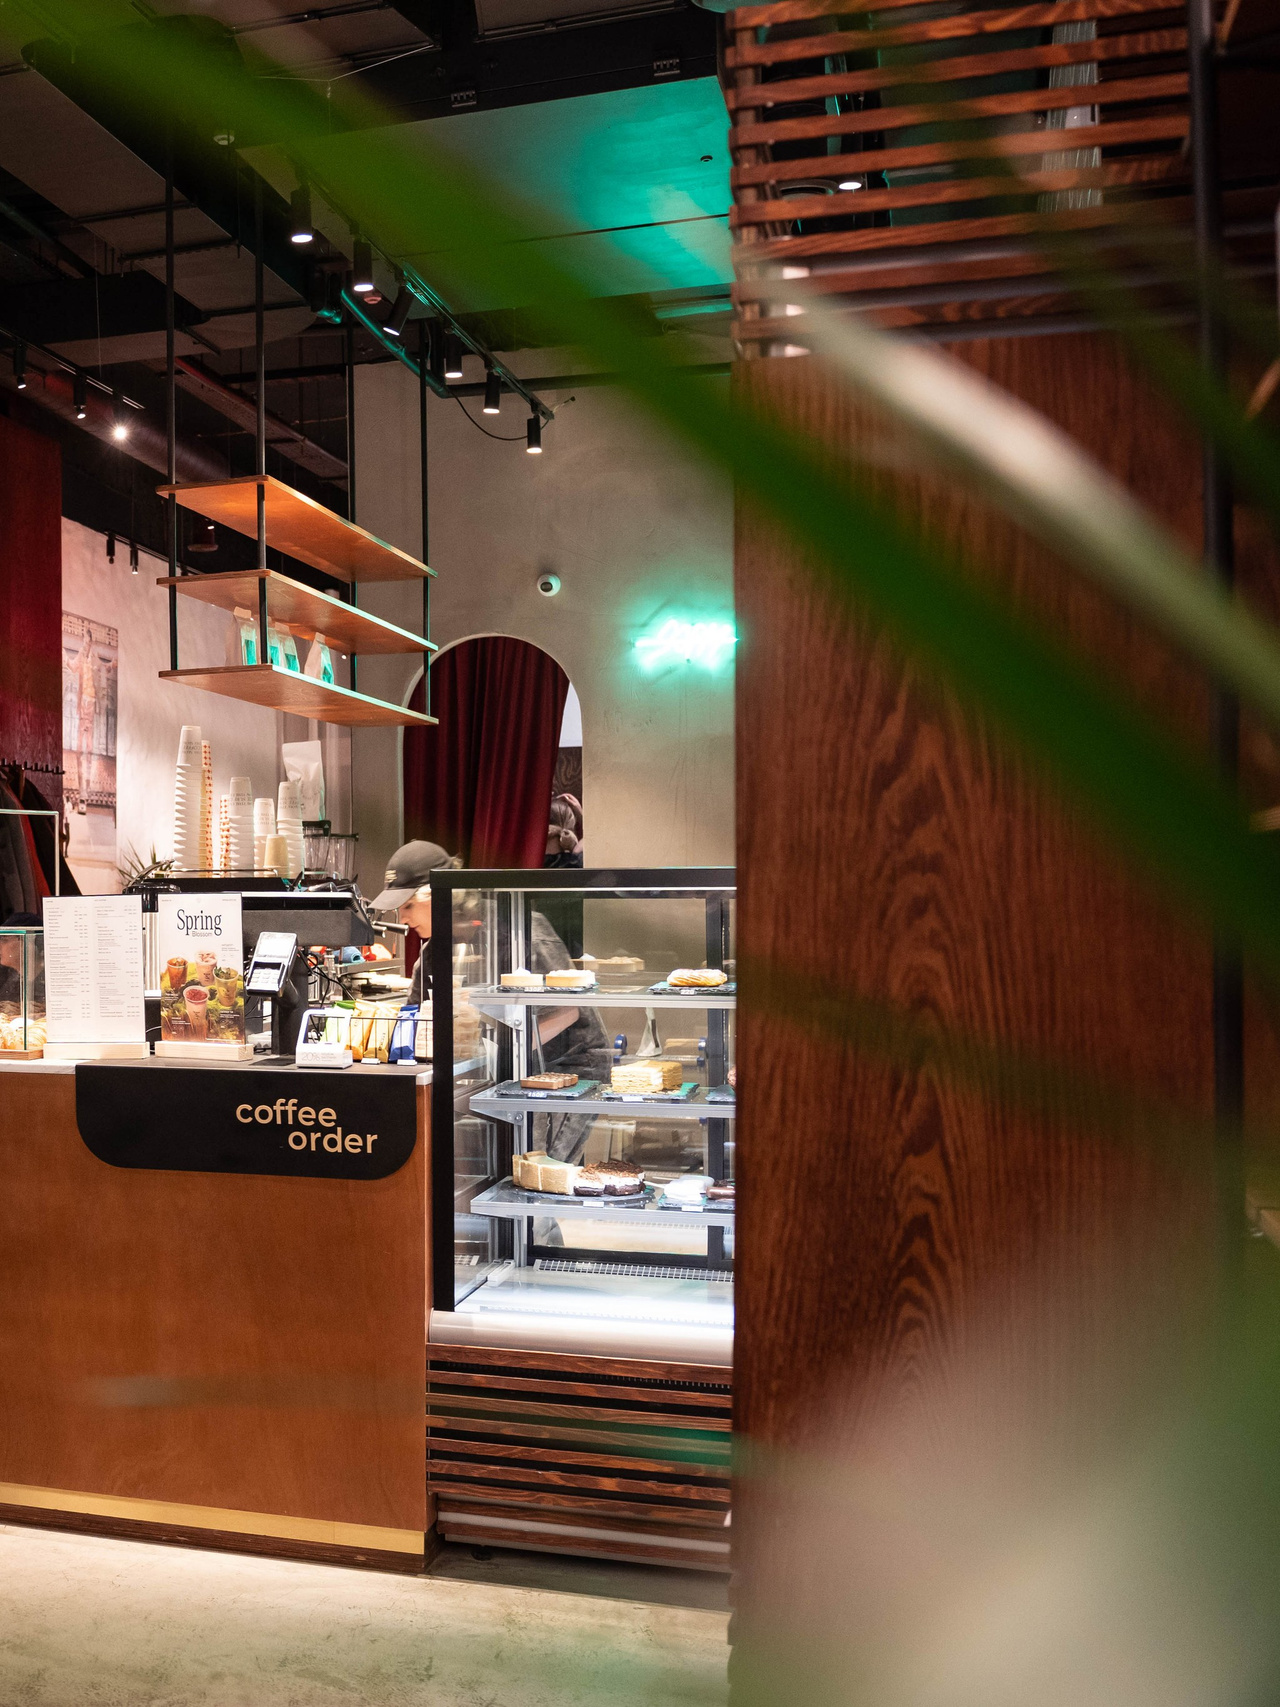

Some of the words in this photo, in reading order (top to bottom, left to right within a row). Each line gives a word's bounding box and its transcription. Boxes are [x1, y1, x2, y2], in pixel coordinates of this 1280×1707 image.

[176, 908, 223, 937] Spring
[191, 930, 214, 938] Blossom
[235, 1098, 337, 1128] coffee
[287, 1127, 378, 1154] order
